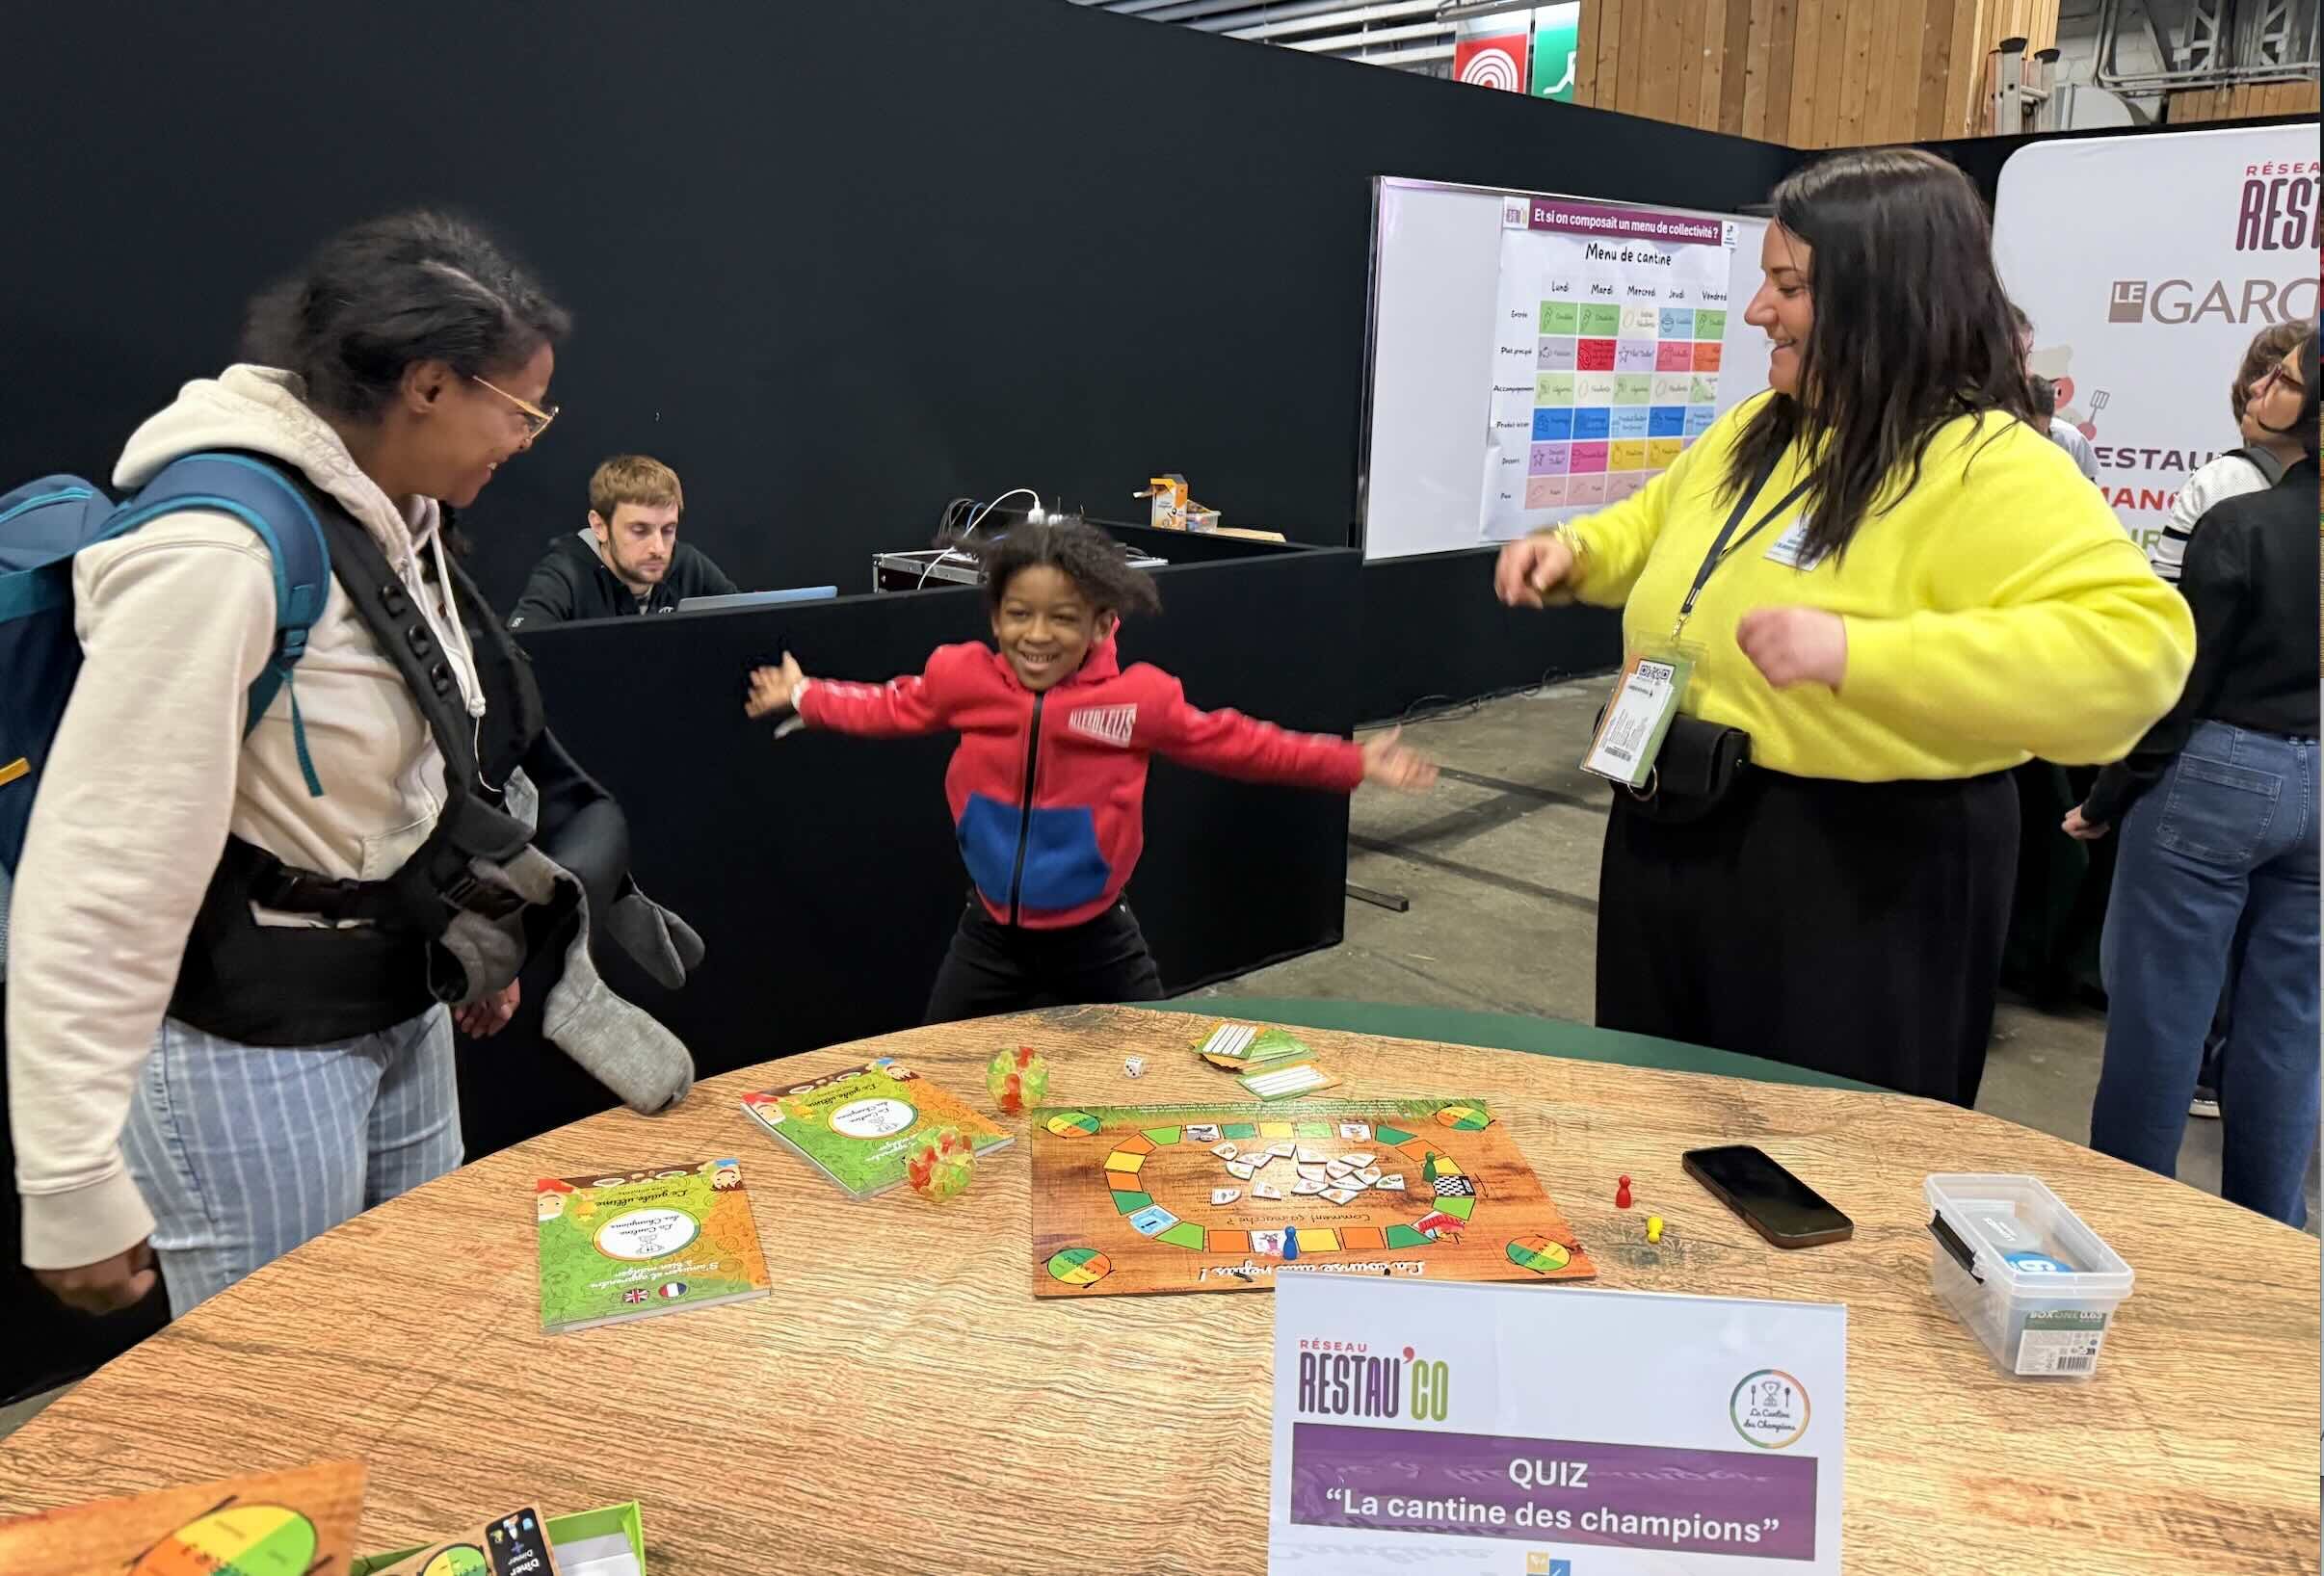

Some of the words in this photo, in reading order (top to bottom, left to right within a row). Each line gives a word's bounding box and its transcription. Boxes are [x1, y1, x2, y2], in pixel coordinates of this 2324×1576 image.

[1534, 208, 1546, 223] Et
[1546, 210, 1555, 223] si
[1555, 212, 1568, 224] on
[1570, 214, 1618, 230] composait
[1619, 219, 1630, 230] un
[1631, 221, 1655, 234] menu
[1656, 221, 1668, 235] de
[1669, 223, 1712, 239] collectivité
[1585, 243, 1617, 262] Menu
[1621, 247, 1633, 263] de
[1637, 250, 1672, 267] cantine
[1591, 283, 1614, 296] Mardi
[1300, 1338, 1367, 1353] RÉSEAU
[1298, 1347, 1449, 1422] RESTAU'CO
[1508, 1458, 1589, 1490] QUIZ
[1386, 1496, 1507, 1526] cantine
[1514, 1500, 1572, 1531] des
